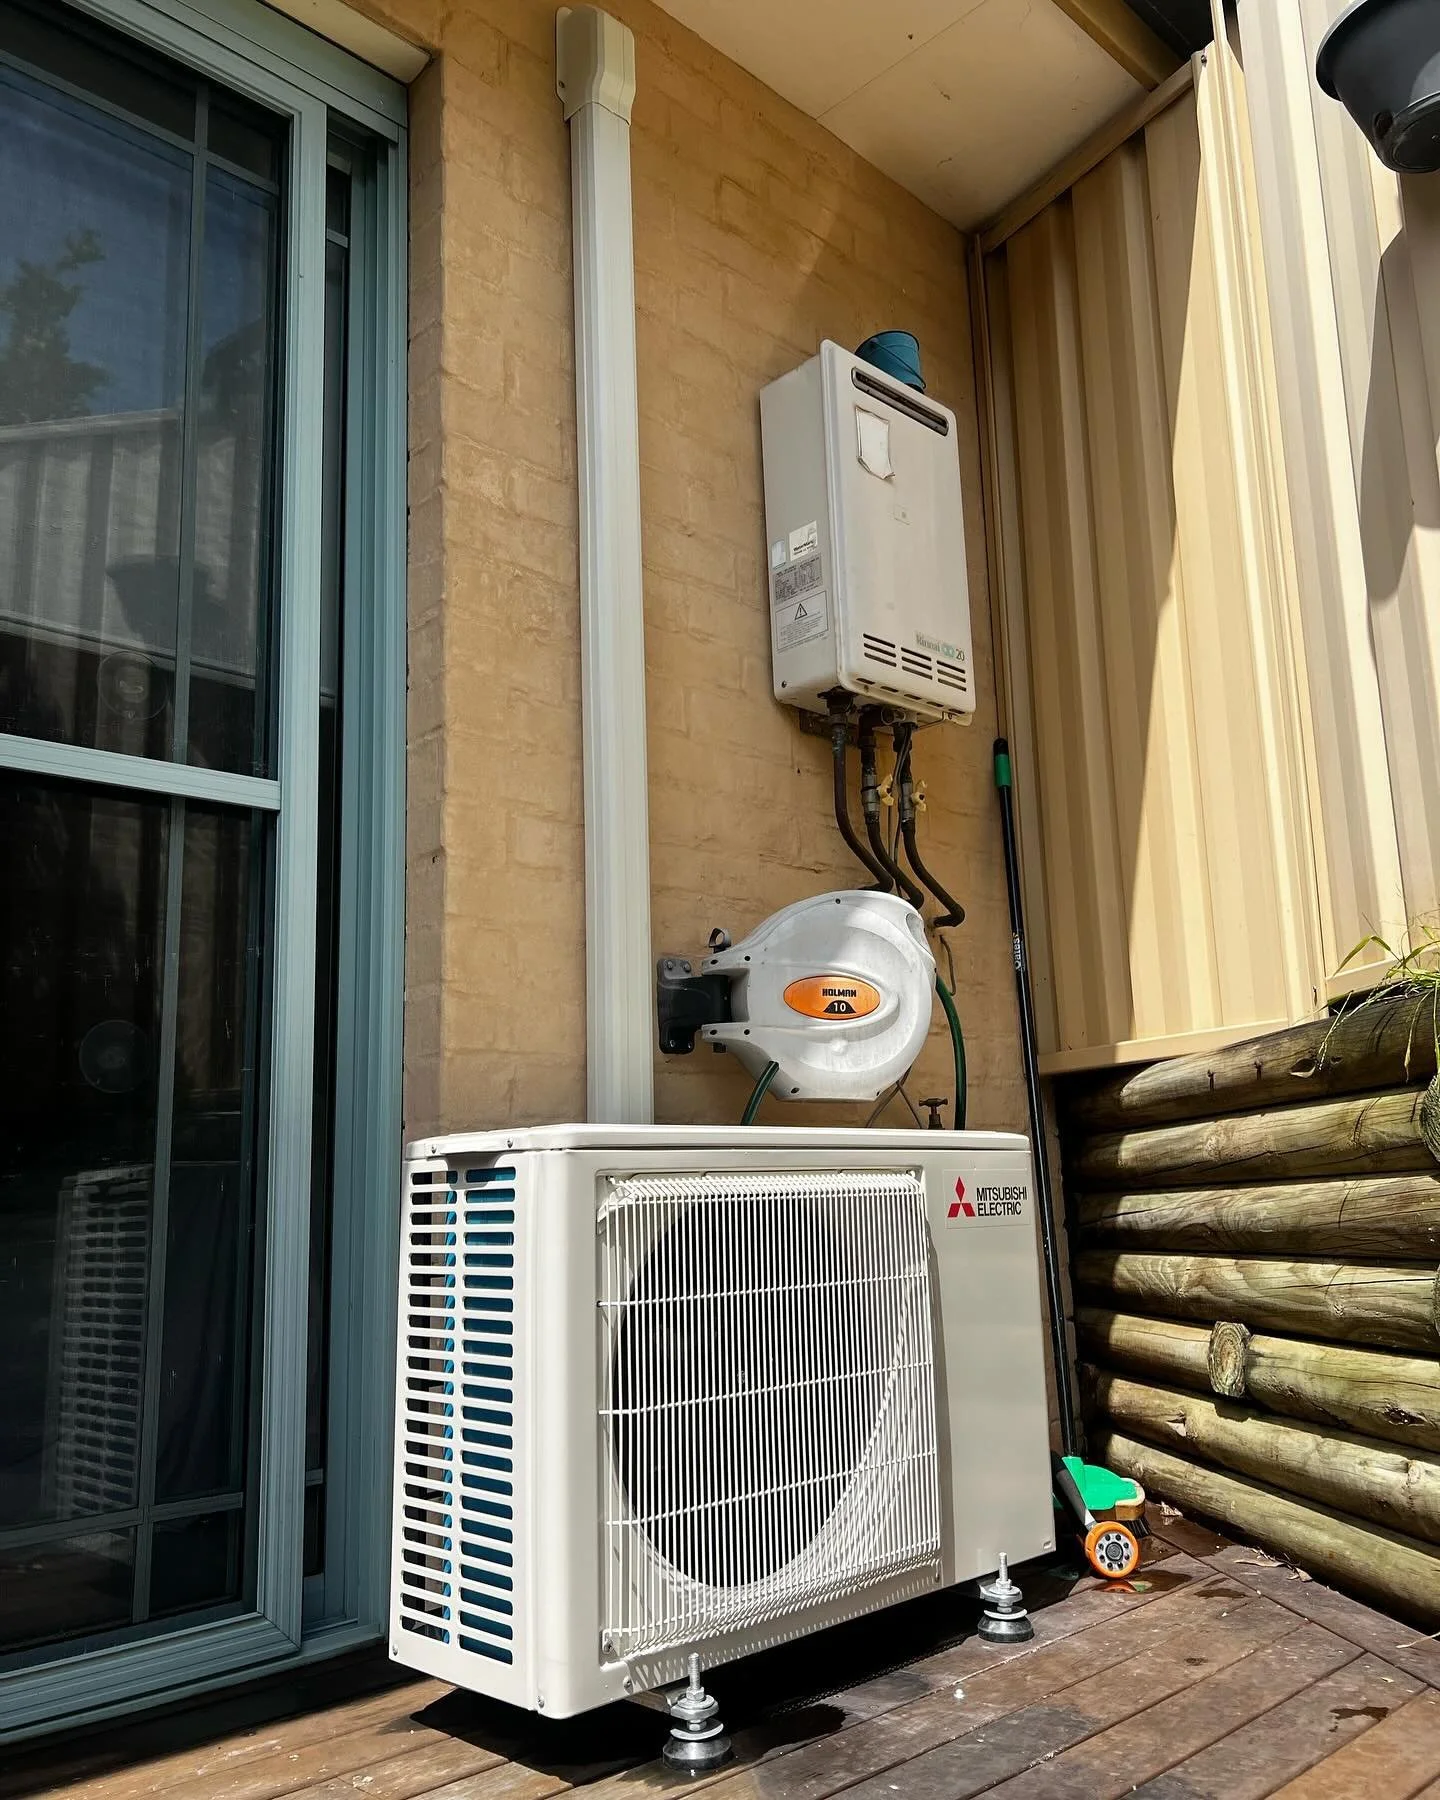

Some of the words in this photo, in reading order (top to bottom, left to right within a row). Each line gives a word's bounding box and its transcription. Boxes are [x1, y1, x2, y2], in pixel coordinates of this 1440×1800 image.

[956, 647, 965, 662] 20
[1013, 936, 1022, 970] Oates
[822, 988, 857, 997] HOLMAN
[834, 1002, 847, 1012] 10
[976, 1186, 1028, 1201] MITSUBISHI
[977, 1202, 1022, 1217] ELECTRIC
